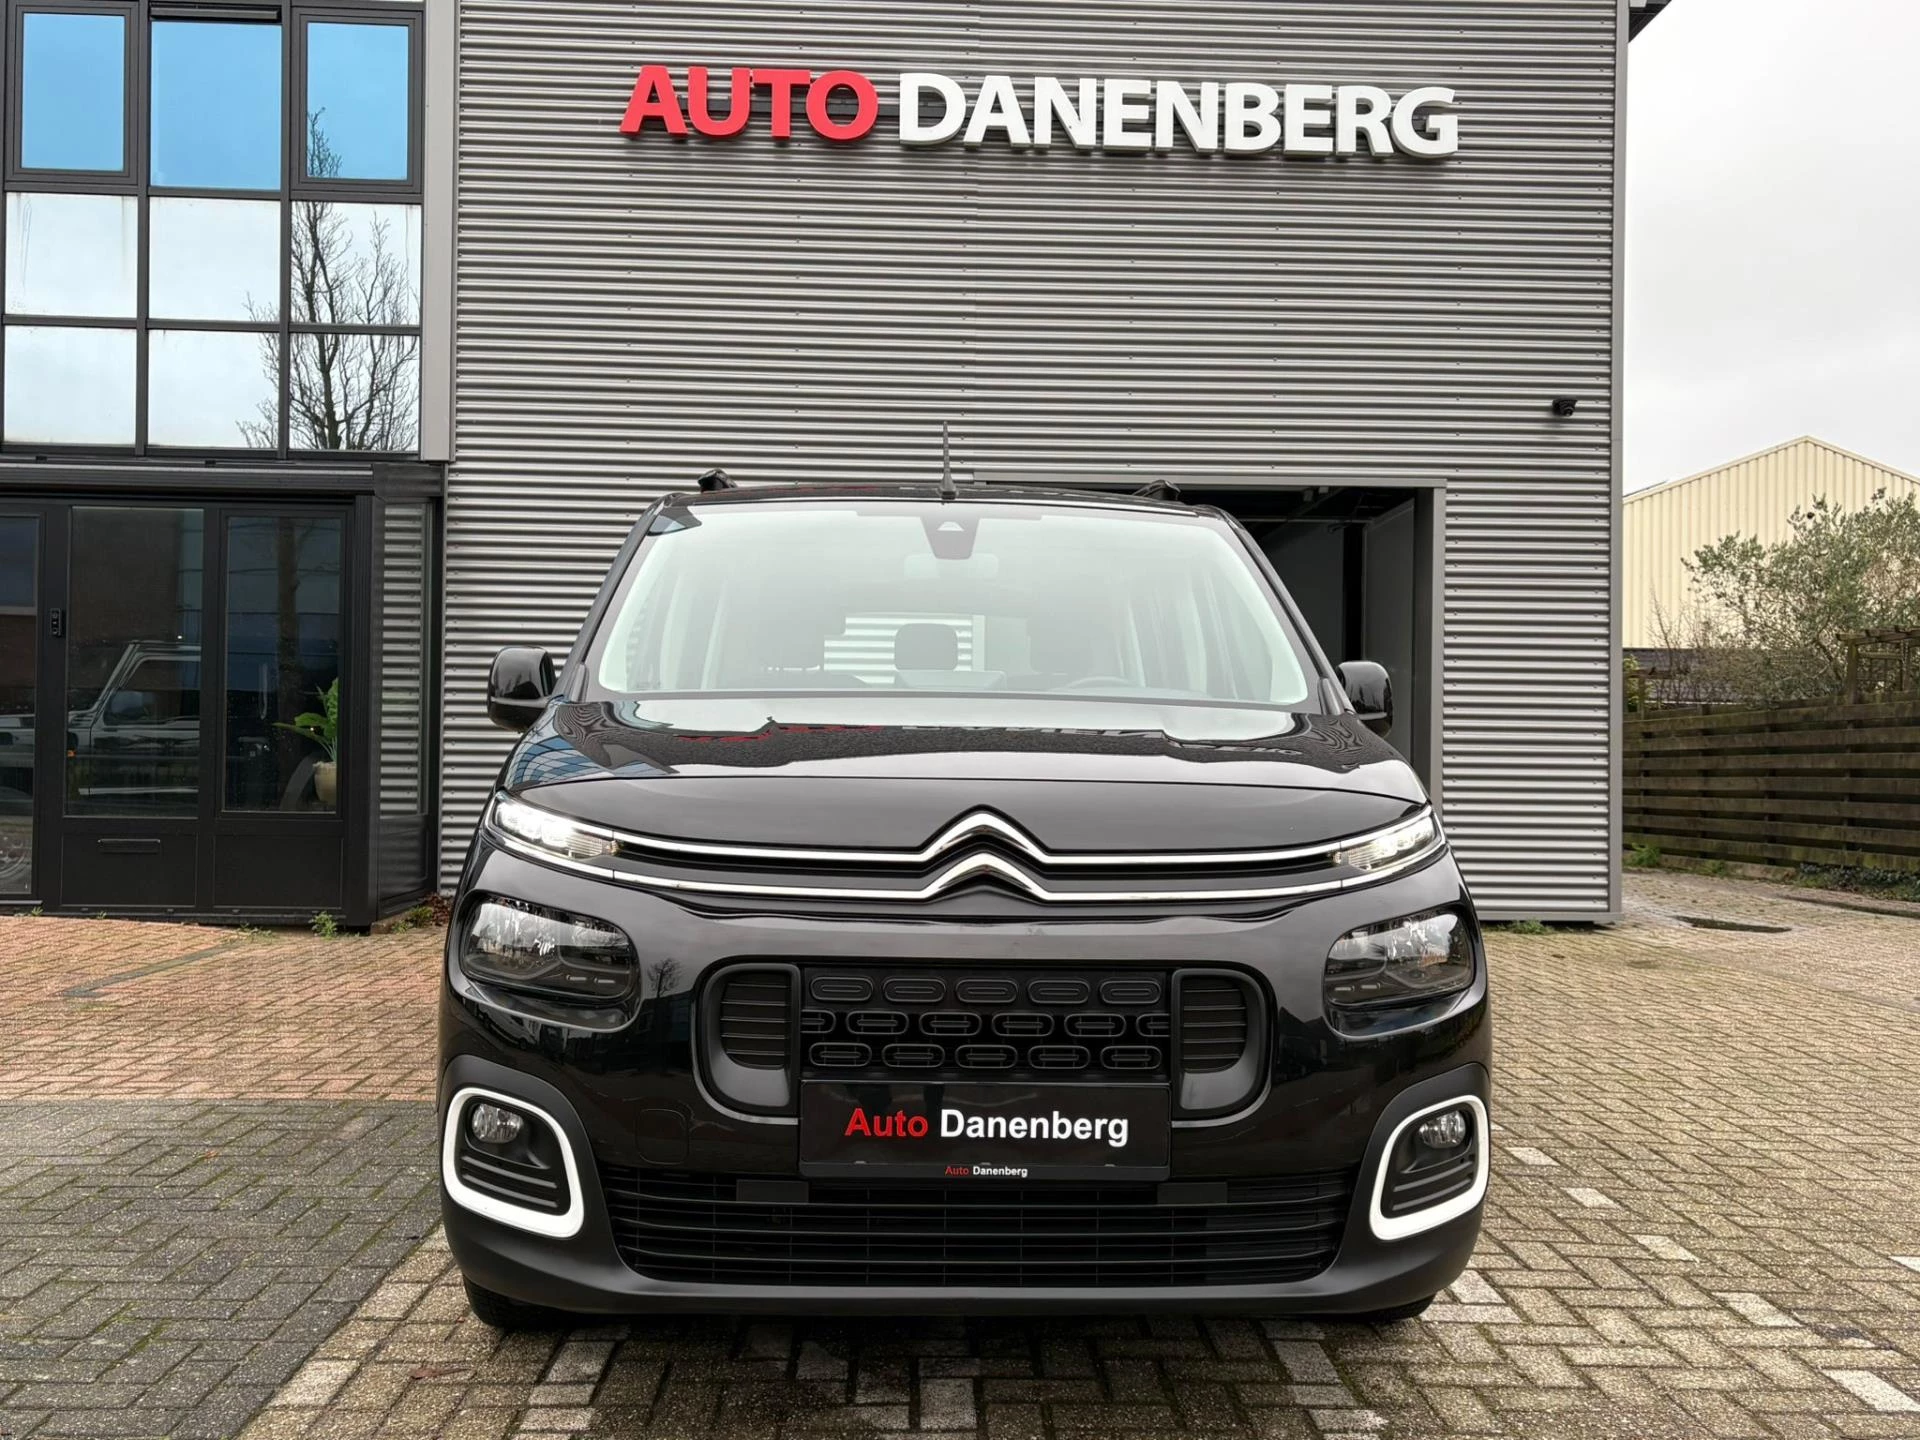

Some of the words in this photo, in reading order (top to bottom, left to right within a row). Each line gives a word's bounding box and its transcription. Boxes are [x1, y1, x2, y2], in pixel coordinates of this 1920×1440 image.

[620, 65, 879, 140] AUTO
[898, 73, 1459, 158] DANENBERG
[845, 1107, 929, 1137] Auto
[940, 1108, 1129, 1147] Danenberg
[945, 1165, 970, 1176] Auto
[972, 1165, 1028, 1178] Danenberg
